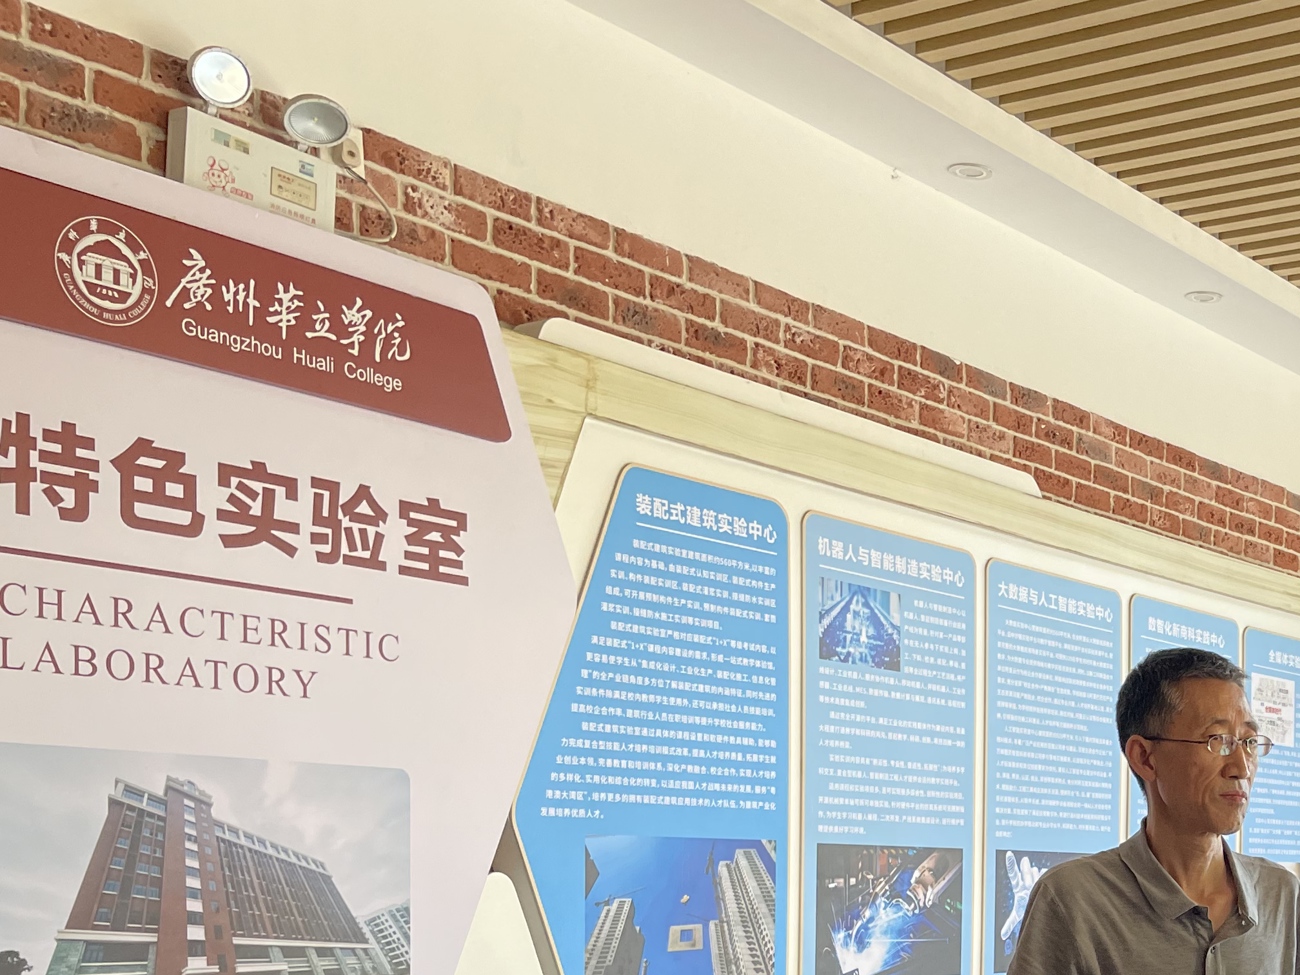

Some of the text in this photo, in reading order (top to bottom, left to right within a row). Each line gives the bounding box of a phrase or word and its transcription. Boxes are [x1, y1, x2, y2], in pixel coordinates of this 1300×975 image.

[63, 272, 151, 322] GUANGZHOU HUALI COLLEGE
[181, 318, 403, 392] Guangzhou Huali College
[0, 411, 469, 587] 特色实验室
[636, 493, 777, 544] 装配式建筑实验中心
[817, 536, 965, 588] 机器人与智能制造实验中心
[0, 582, 401, 663] CHARACTERISTIC
[998, 580, 1113, 623] 大数据与人工智能实验中心
[1148, 616, 1226, 649] 数智化新商科实践中心
[0, 636, 318, 700] LABORATORY
